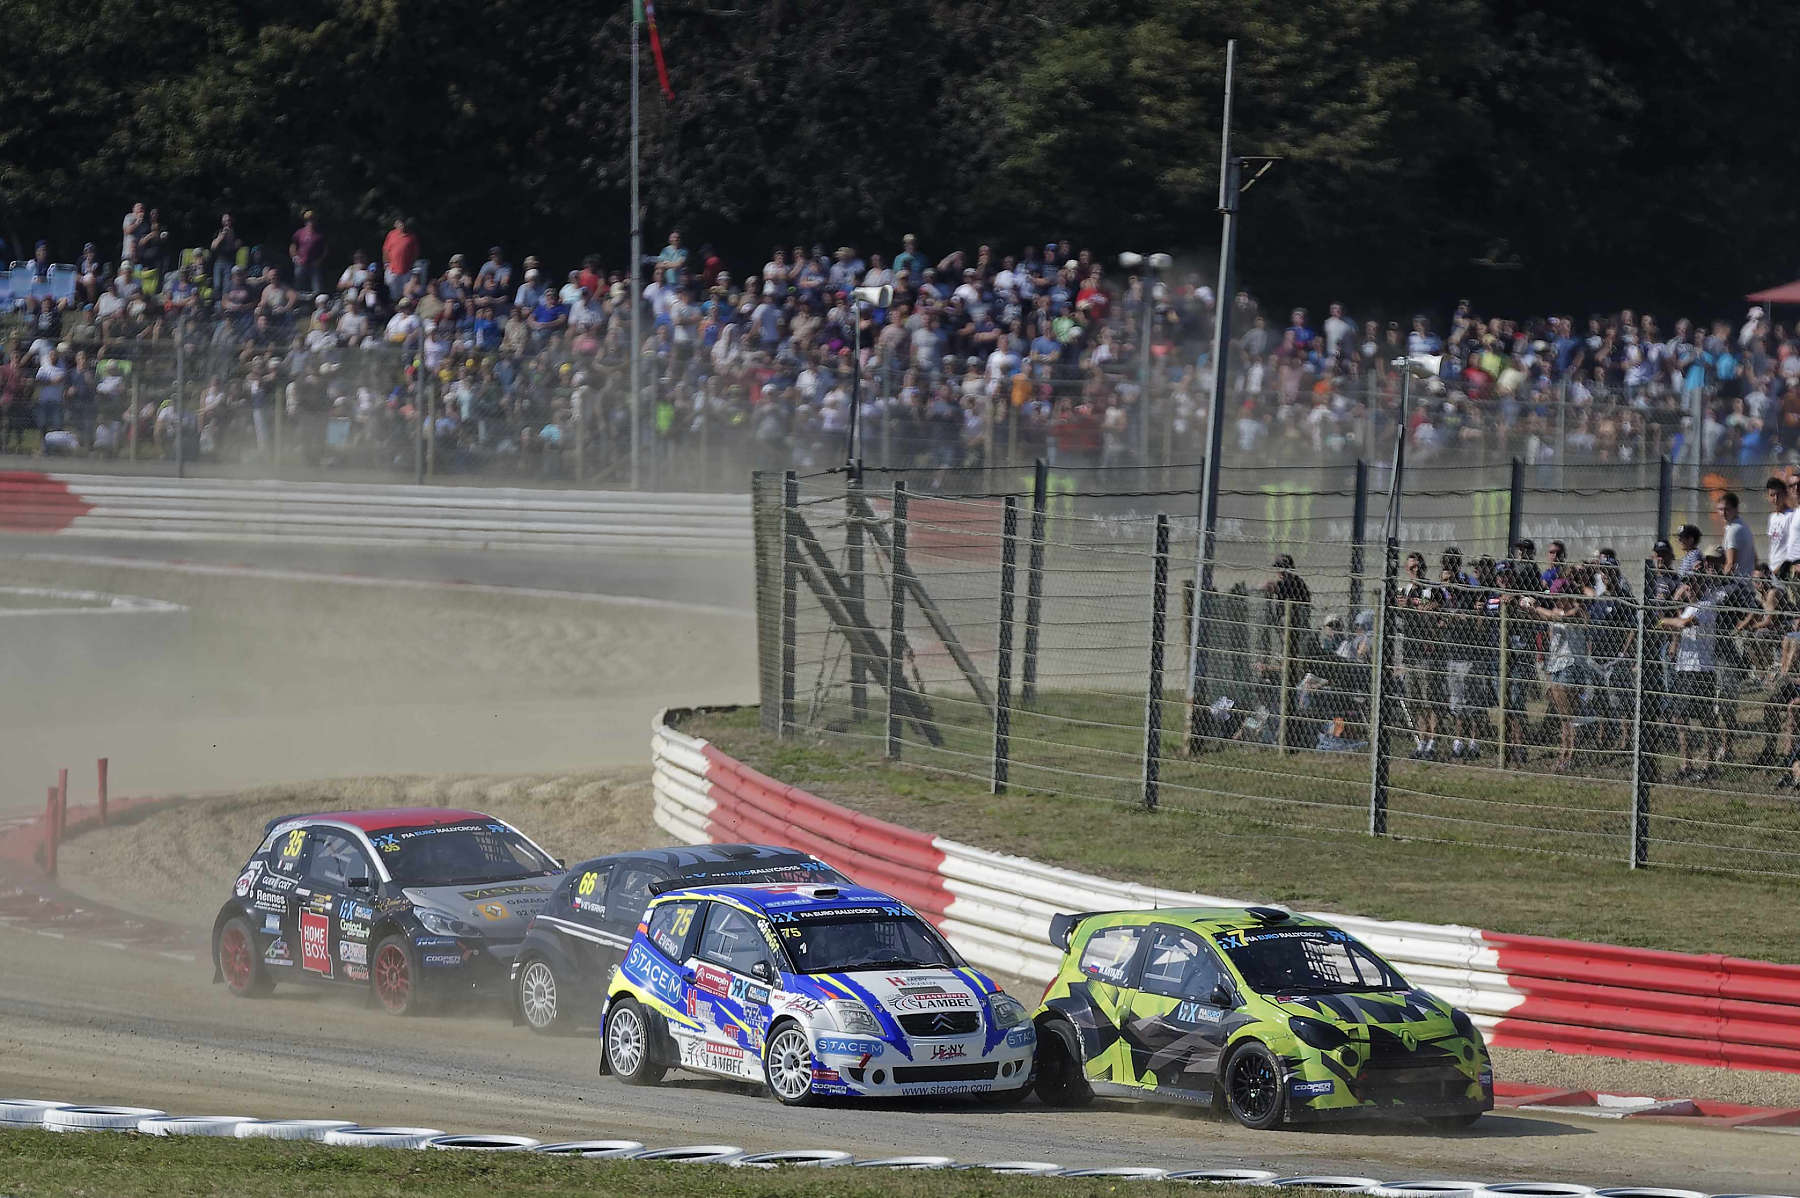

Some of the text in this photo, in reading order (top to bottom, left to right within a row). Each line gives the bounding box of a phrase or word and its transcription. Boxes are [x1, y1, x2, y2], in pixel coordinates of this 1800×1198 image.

[284, 830, 306, 856] 35
[579, 871, 598, 896] 66
[257, 889, 286, 905] Rennes
[670, 908, 694, 937] 75
[814, 910, 835, 918] EURO
[304, 926, 325, 944] HOME
[780, 927, 802, 938] 75
[1227, 929, 1249, 947] 7
[305, 942, 326, 960] BOX
[658, 932, 679, 957] EVENO
[630, 946, 682, 1000] STACEM
[707, 1043, 743, 1058] TRANSPORTS
[818, 1040, 882, 1054] STACEM
[901, 1083, 993, 1096] www.stacem.com
[1294, 1083, 1331, 1091] COOPER
